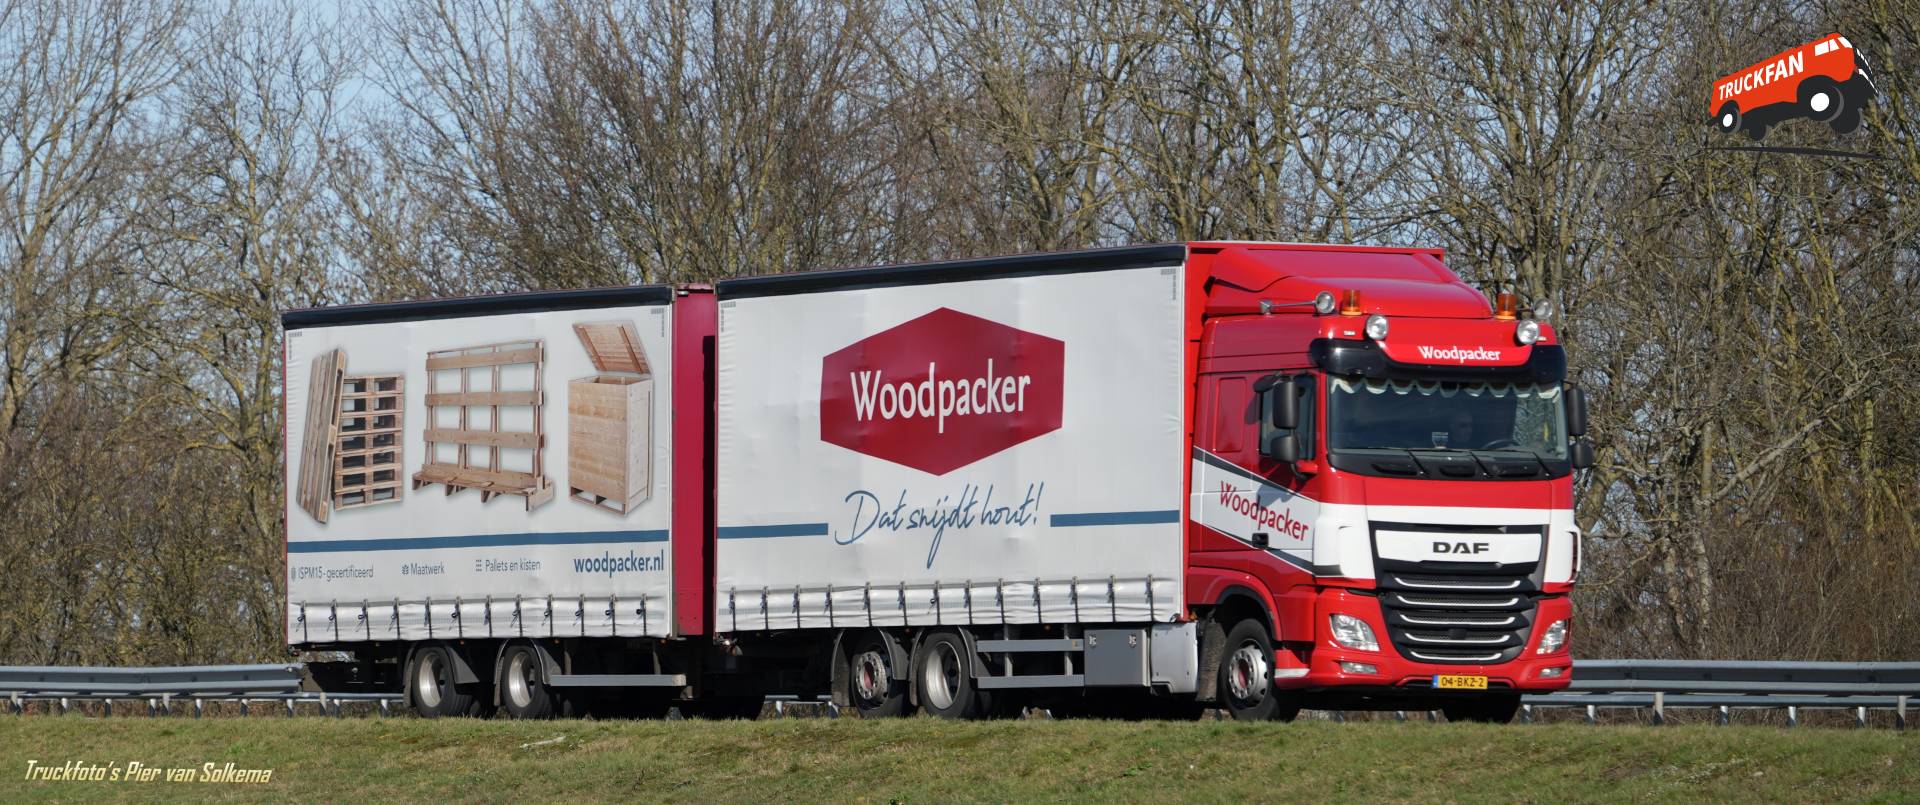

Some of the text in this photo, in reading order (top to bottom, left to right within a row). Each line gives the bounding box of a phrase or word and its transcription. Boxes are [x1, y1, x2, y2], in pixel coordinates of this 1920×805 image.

[1417, 346, 1501, 364] Woodpacker
[850, 358, 1031, 434] Woodpacker
[1219, 480, 1309, 541] Woodpacker
[834, 481, 1045, 570] Dat snijdt hout!
[1432, 541, 1490, 554] DAF
[410, 561, 445, 575] Maatwerk
[485, 558, 541, 572] Pallets en kisten
[573, 549, 665, 578] woodpacker.nl
[1441, 676, 1485, 688] 04-BKZ-2
